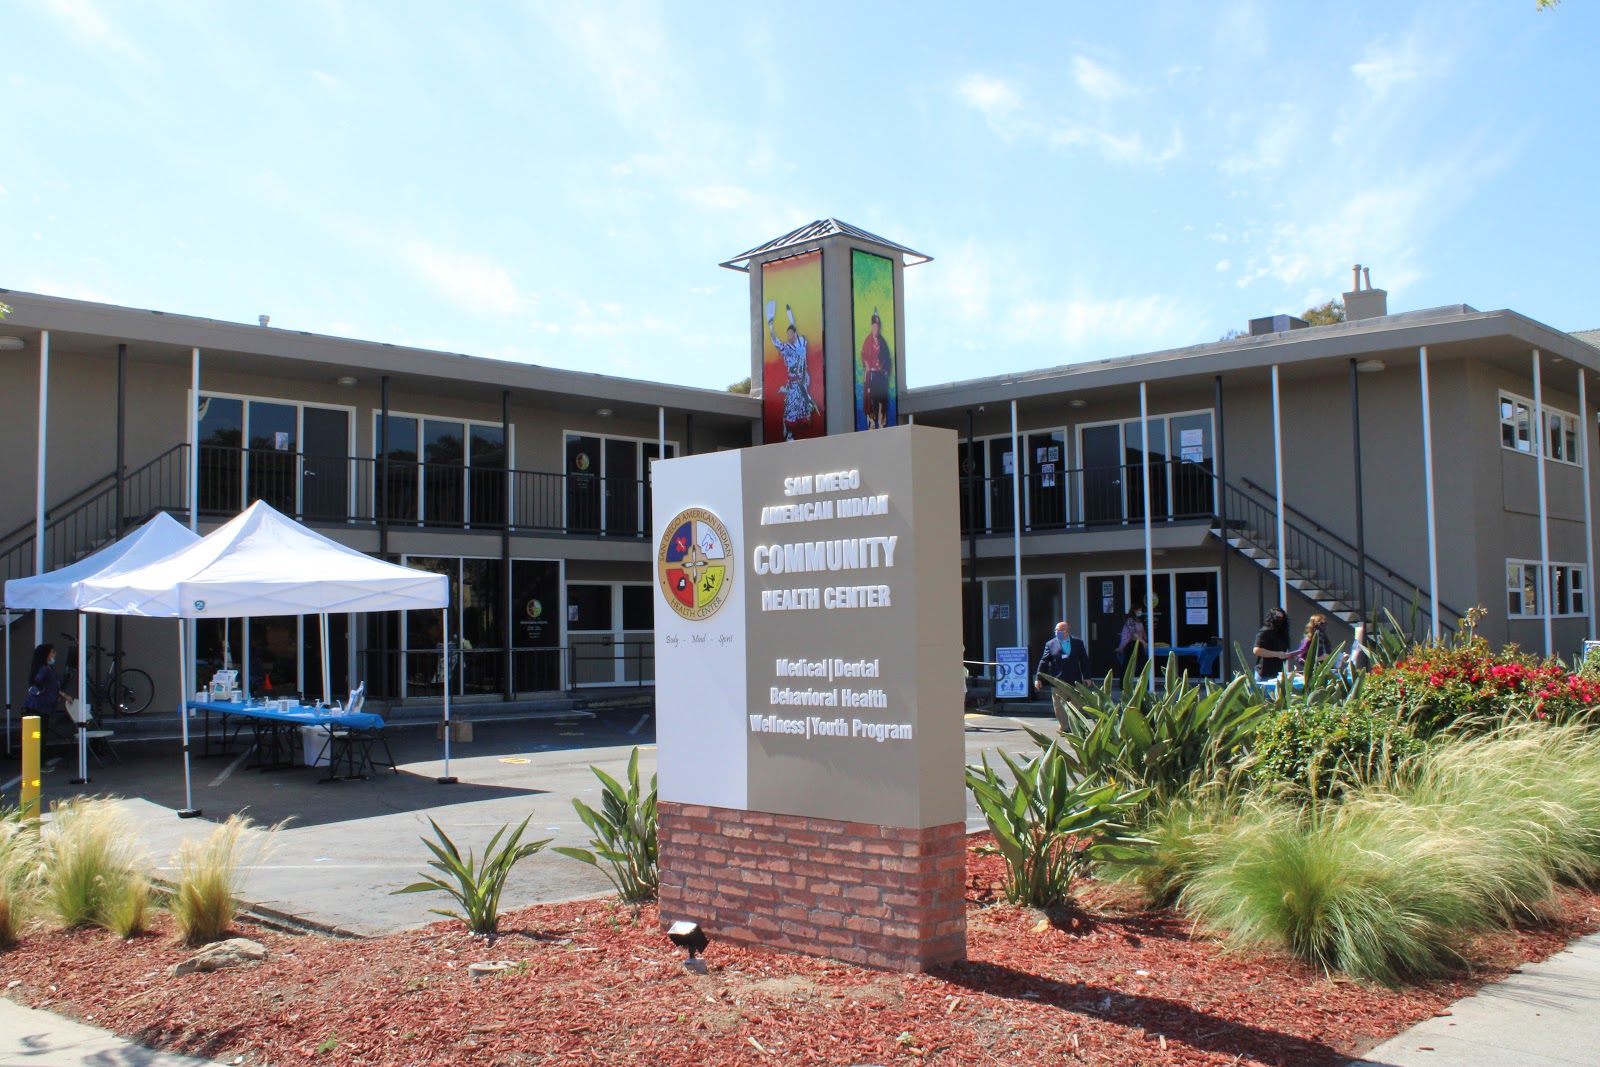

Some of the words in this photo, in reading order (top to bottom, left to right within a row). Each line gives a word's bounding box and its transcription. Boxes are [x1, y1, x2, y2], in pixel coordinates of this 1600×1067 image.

[784, 475, 812, 496] SAN
[816, 469, 860, 493] DIEGO
[761, 500, 833, 525] AMERICAN
[837, 494, 888, 518] INDIAN
[664, 518, 681, 541] DIEGO
[682, 509, 717, 526] AMERICAN
[716, 524, 731, 557] INDIAN
[754, 535, 898, 575] COMMUNITY
[671, 598, 695, 617] HEALTH
[697, 597, 721, 617] CENTER
[762, 588, 820, 612] HEALTH
[824, 584, 892, 610] CENTER
[666, 634, 678, 647] Body
[691, 632, 707, 643] Mind
[718, 633, 734, 647] Spirit
[770, 687, 838, 706] Behavioral
[841, 688, 887, 708] Health
[852, 719, 913, 742] Program
